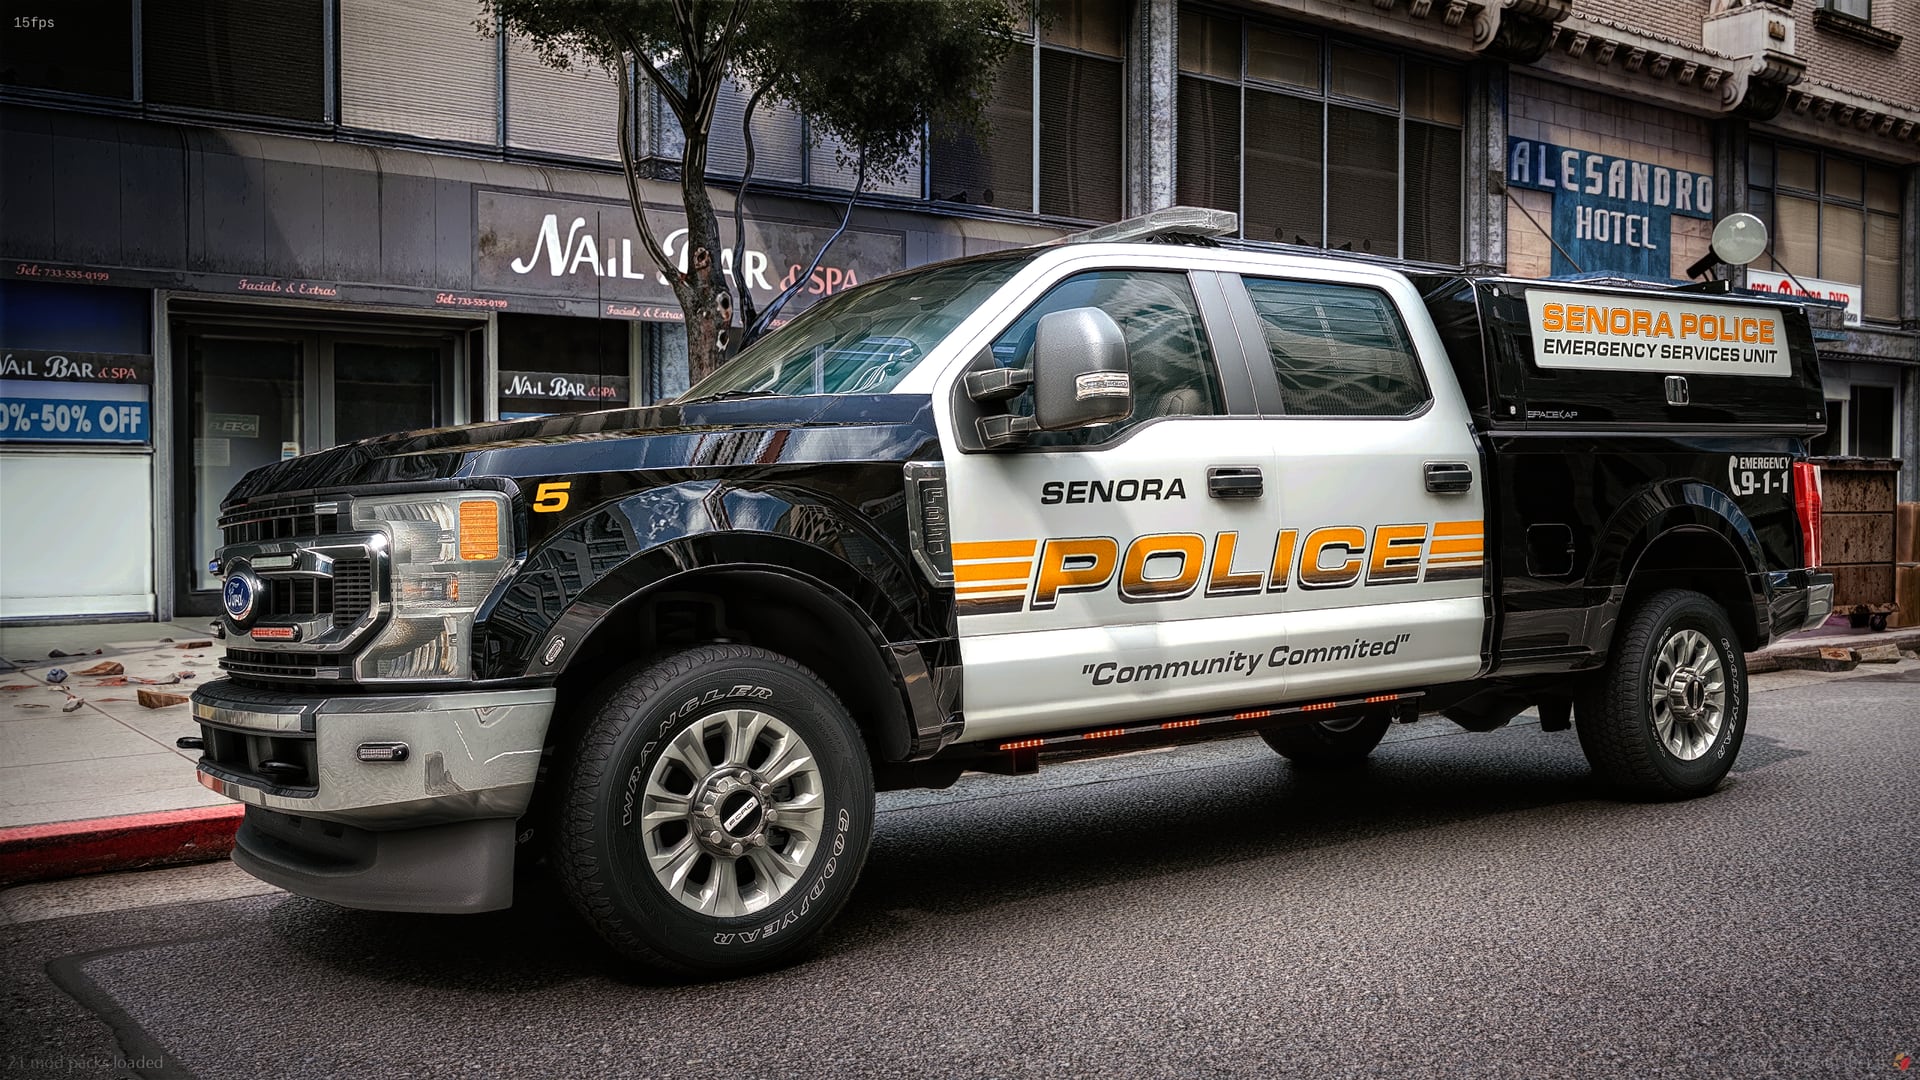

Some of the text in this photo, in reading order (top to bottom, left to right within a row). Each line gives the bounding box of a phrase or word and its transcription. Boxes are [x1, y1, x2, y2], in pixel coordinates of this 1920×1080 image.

[1511, 141, 1713, 214] ALESANDRO
[1576, 205, 1657, 250] HOTEL
[16, 263, 110, 281] Tel: 733-555-0199
[238, 279, 337, 296] Facials & Extras
[436, 293, 508, 308] Tel: 733-555-0199
[606, 304, 684, 320] Facials & Extras
[1543, 303, 1777, 345] SENORA POLICE
[1543, 339, 1779, 364] EMERGENCY SERVICES UNIT
[44, 355, 95, 379] BAR
[111, 367, 137, 380] SPA
[549, 376, 586, 397] BAR
[99, 405, 142, 434] OFF
[208, 421, 257, 432] FLEECA
[1527, 409, 1578, 419] SPACEKAP
[1739, 456, 1791, 470] EMERGENCY
[1040, 478, 1187, 504] SENORA
[1741, 470, 1789, 495] 9-1-1
[532, 481, 572, 513] 5
[1030, 523, 1429, 612] POLICE
[227, 581, 246, 608] Ford
[1082, 634, 1411, 686] "Community Commited"
[1720, 637, 1741, 760] GOODYEAR
[622, 684, 774, 826] WRANGLER
[713, 807, 850, 945] GOODYEAR
